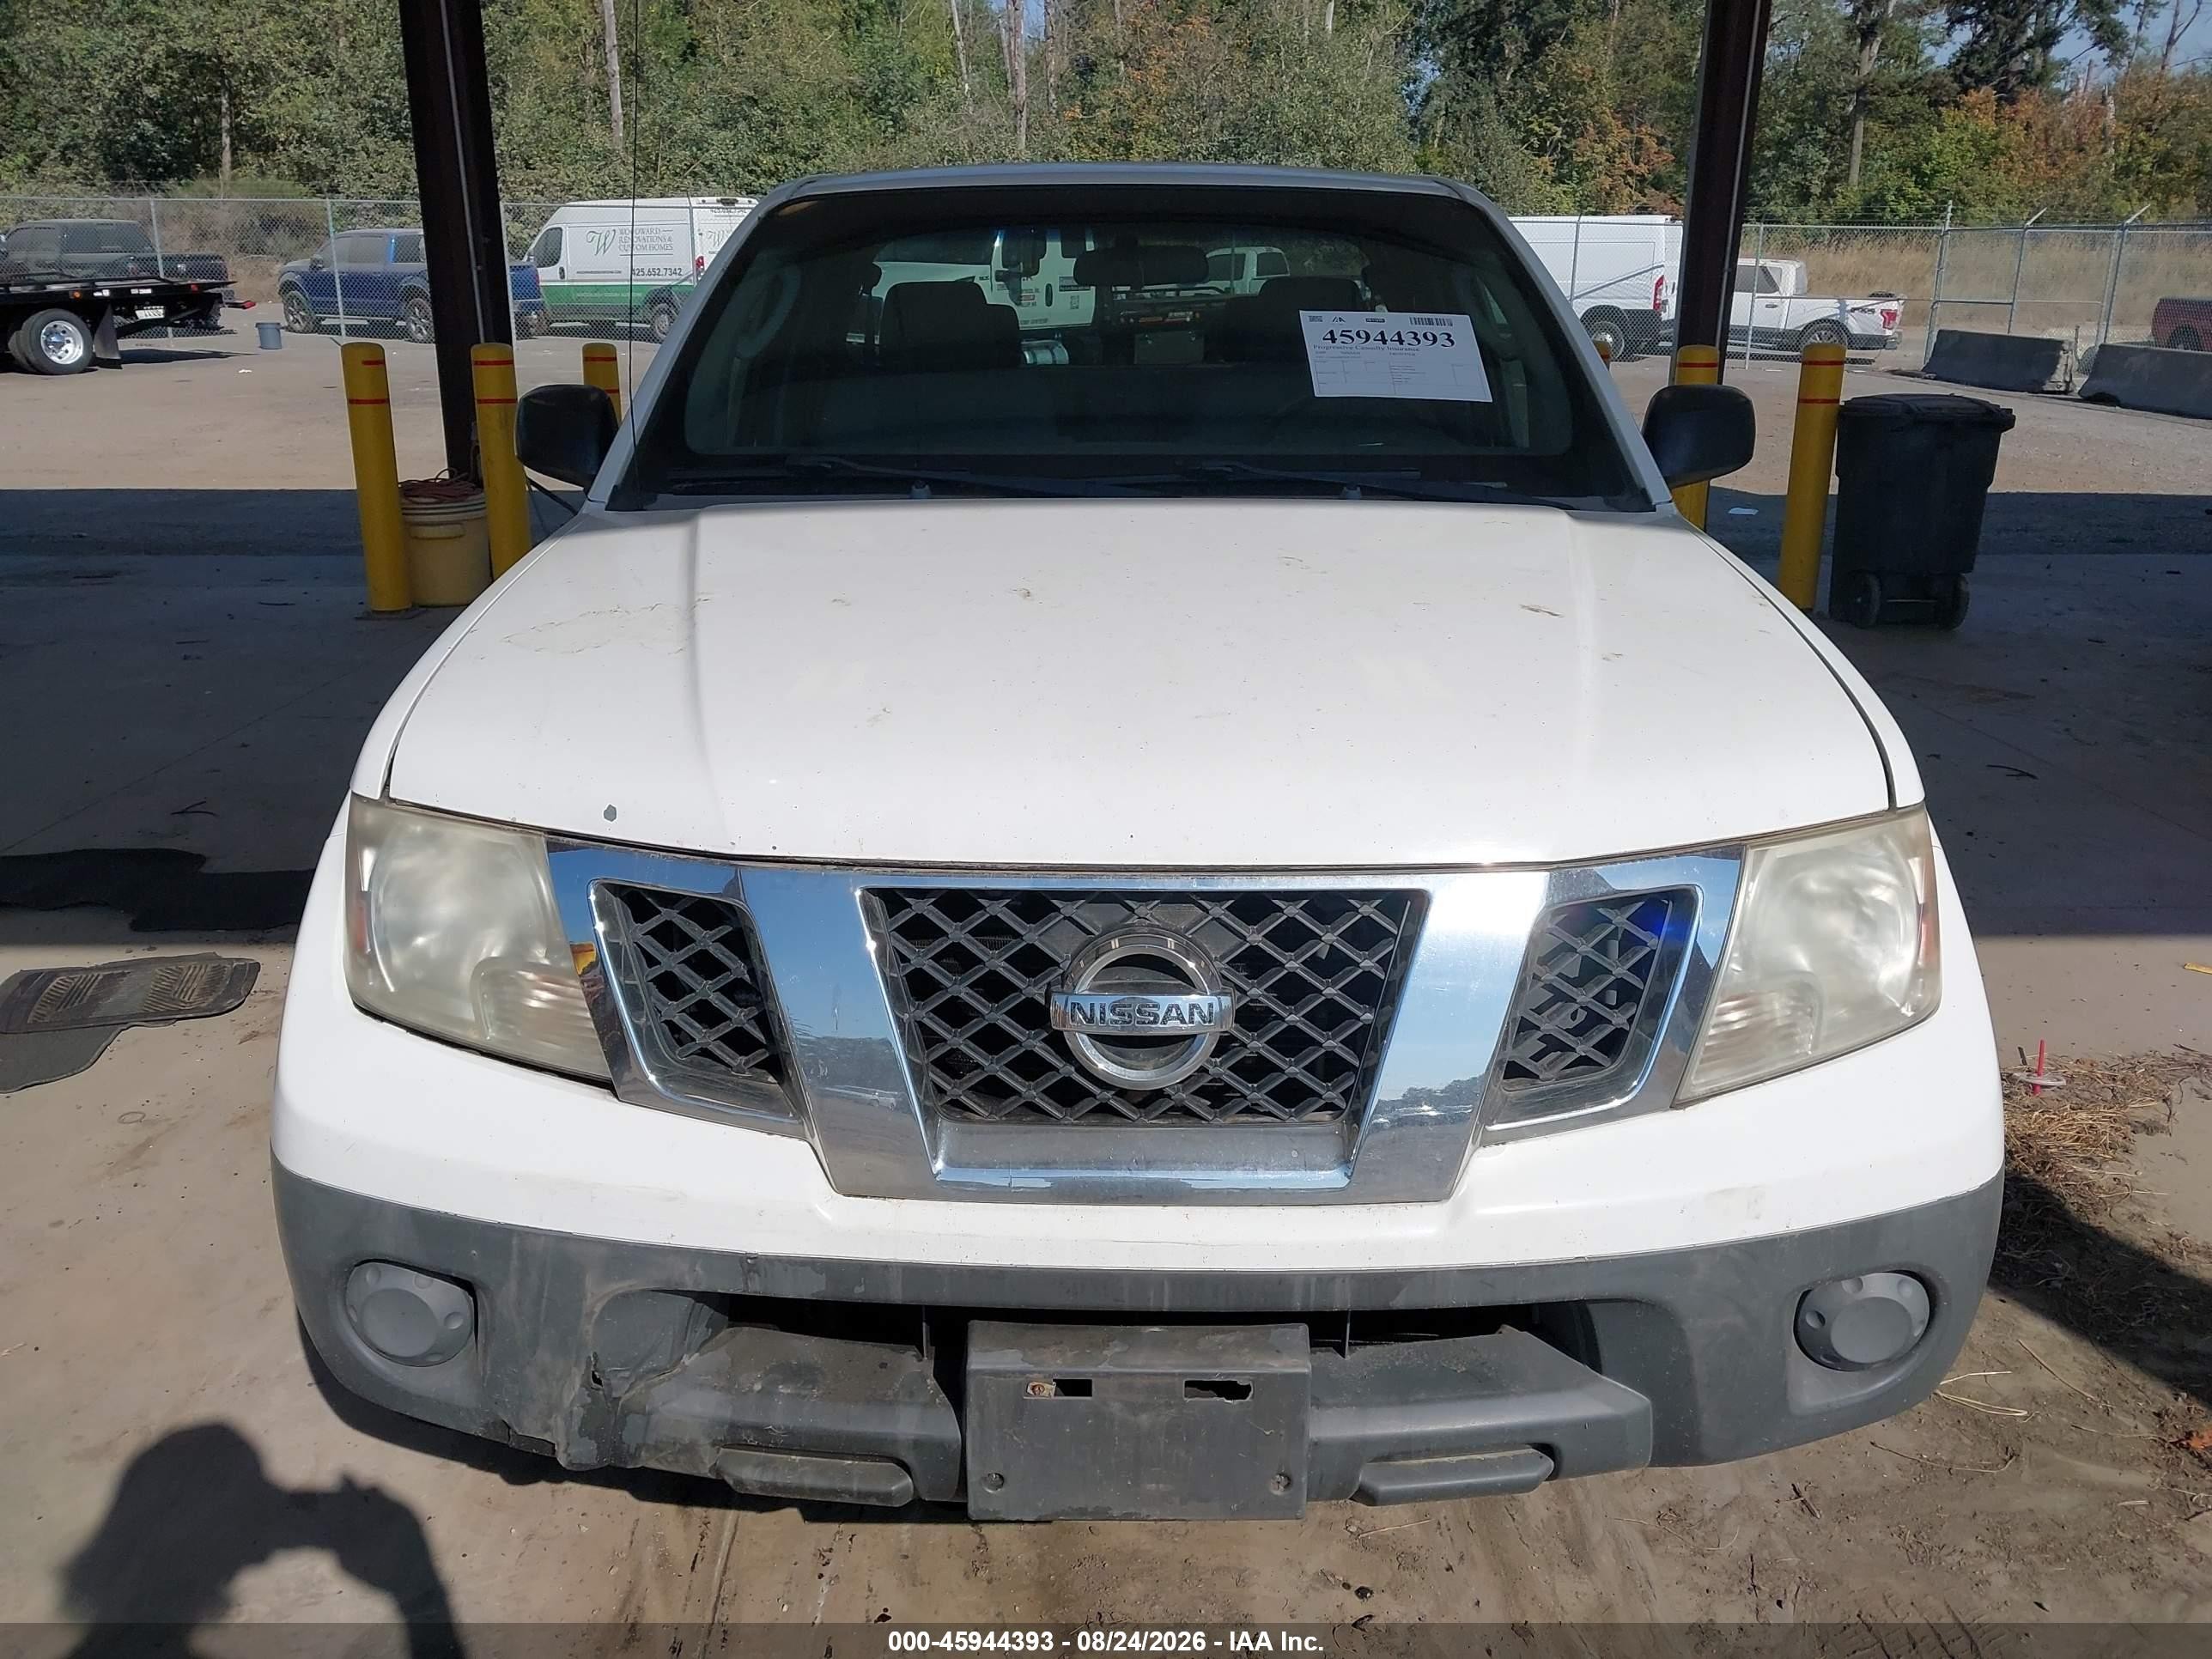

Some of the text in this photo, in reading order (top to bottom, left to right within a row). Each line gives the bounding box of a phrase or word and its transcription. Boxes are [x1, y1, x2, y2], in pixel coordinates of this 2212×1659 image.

[586, 229, 617, 256] W
[632, 267, 683, 276] 425.652.7342
[1322, 329, 1455, 348] 45944393
[1070, 1002, 1215, 1025] NISSAN
